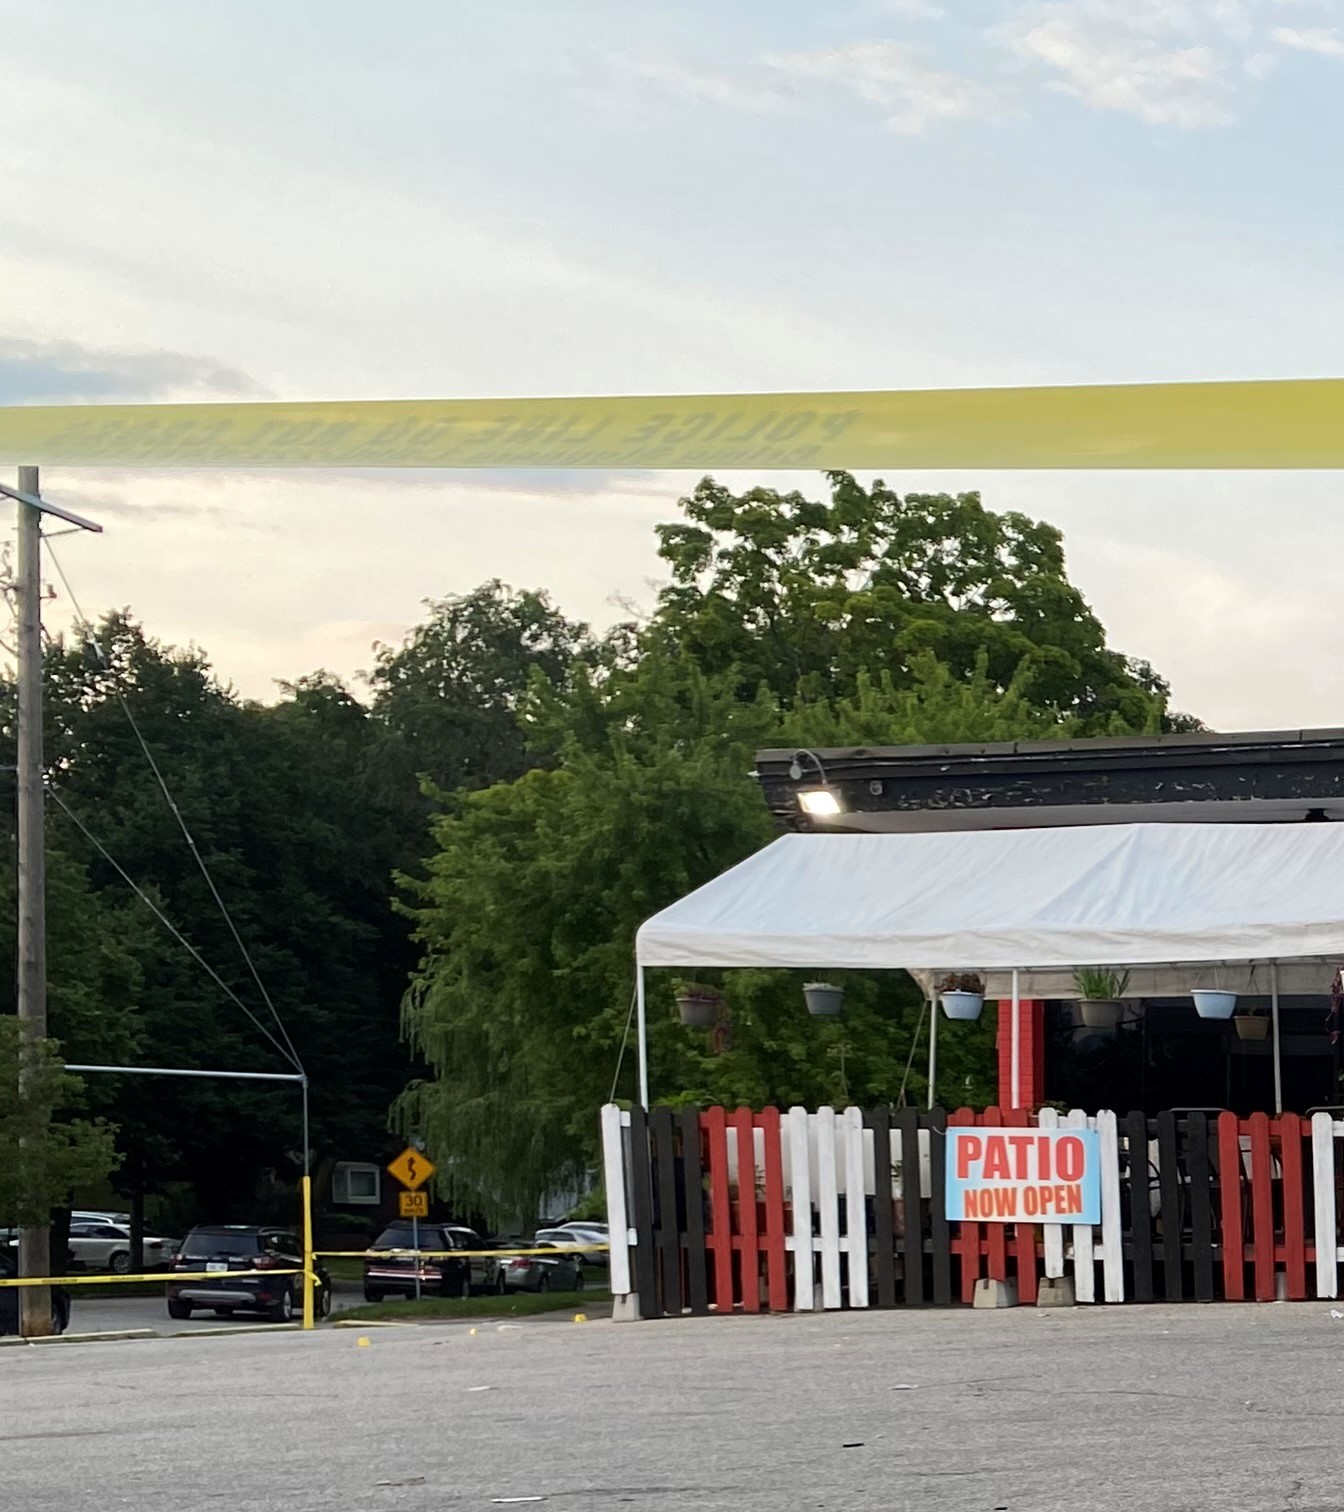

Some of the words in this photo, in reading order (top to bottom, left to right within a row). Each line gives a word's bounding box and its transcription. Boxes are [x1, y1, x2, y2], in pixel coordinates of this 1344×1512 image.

[957, 1135, 1085, 1182] PATIO
[404, 1194, 423, 1207] 30
[964, 1187, 1017, 1218] NOW
[1023, 1184, 1083, 1216] OPEN
